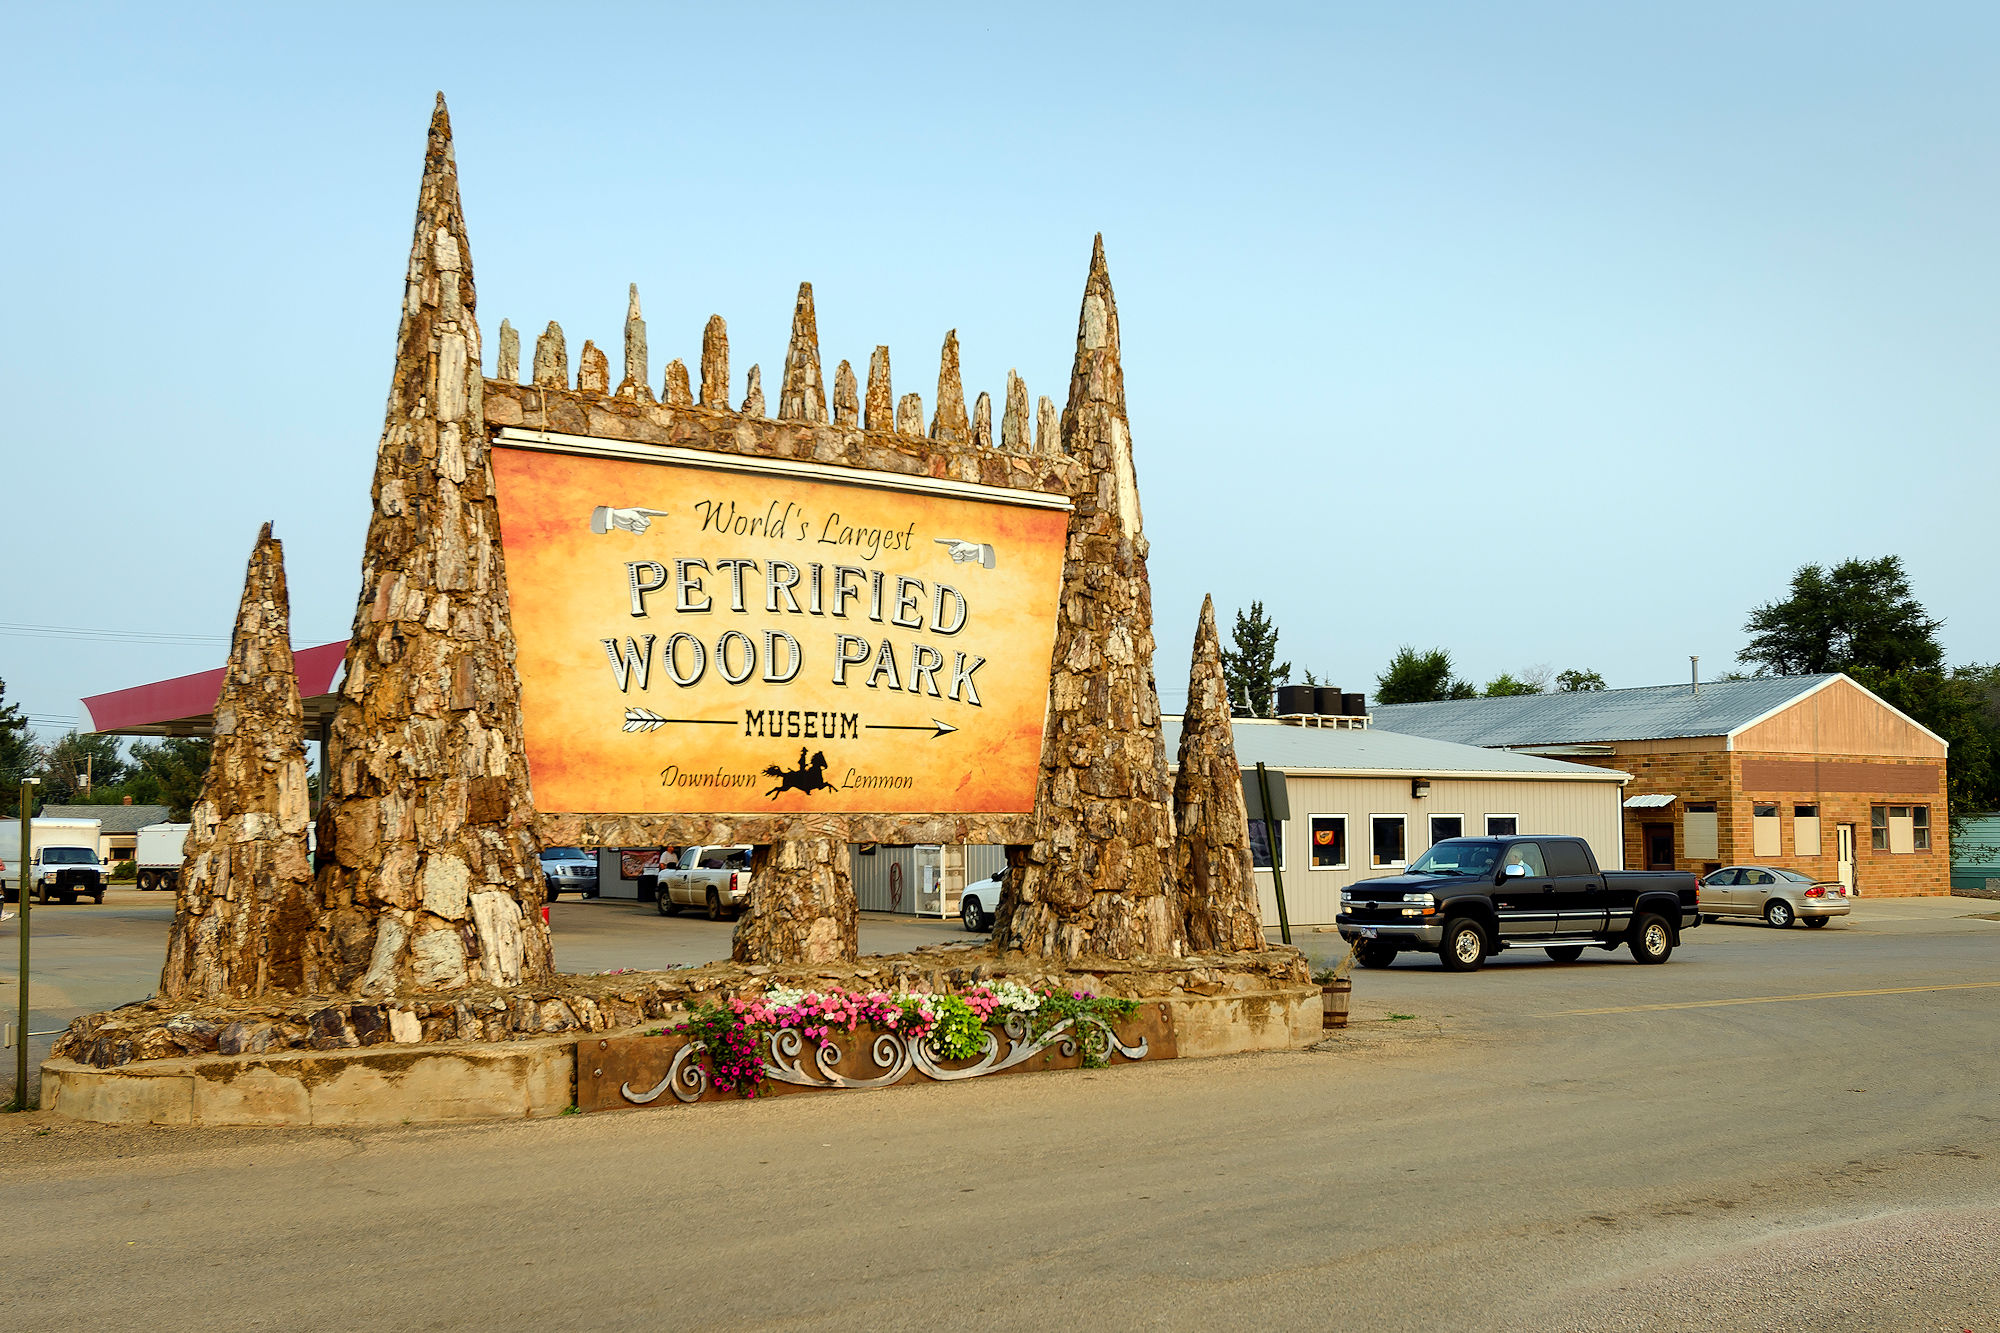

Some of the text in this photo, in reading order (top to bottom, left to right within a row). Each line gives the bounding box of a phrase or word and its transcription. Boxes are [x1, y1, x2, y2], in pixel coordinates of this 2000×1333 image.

[695, 500, 916, 560] World's Largest
[624, 558, 970, 636] PETRIFIED
[600, 630, 987, 707] WOOD PARK
[745, 709, 859, 739] MUSEUM
[660, 765, 913, 790] Downtown Lemmon
